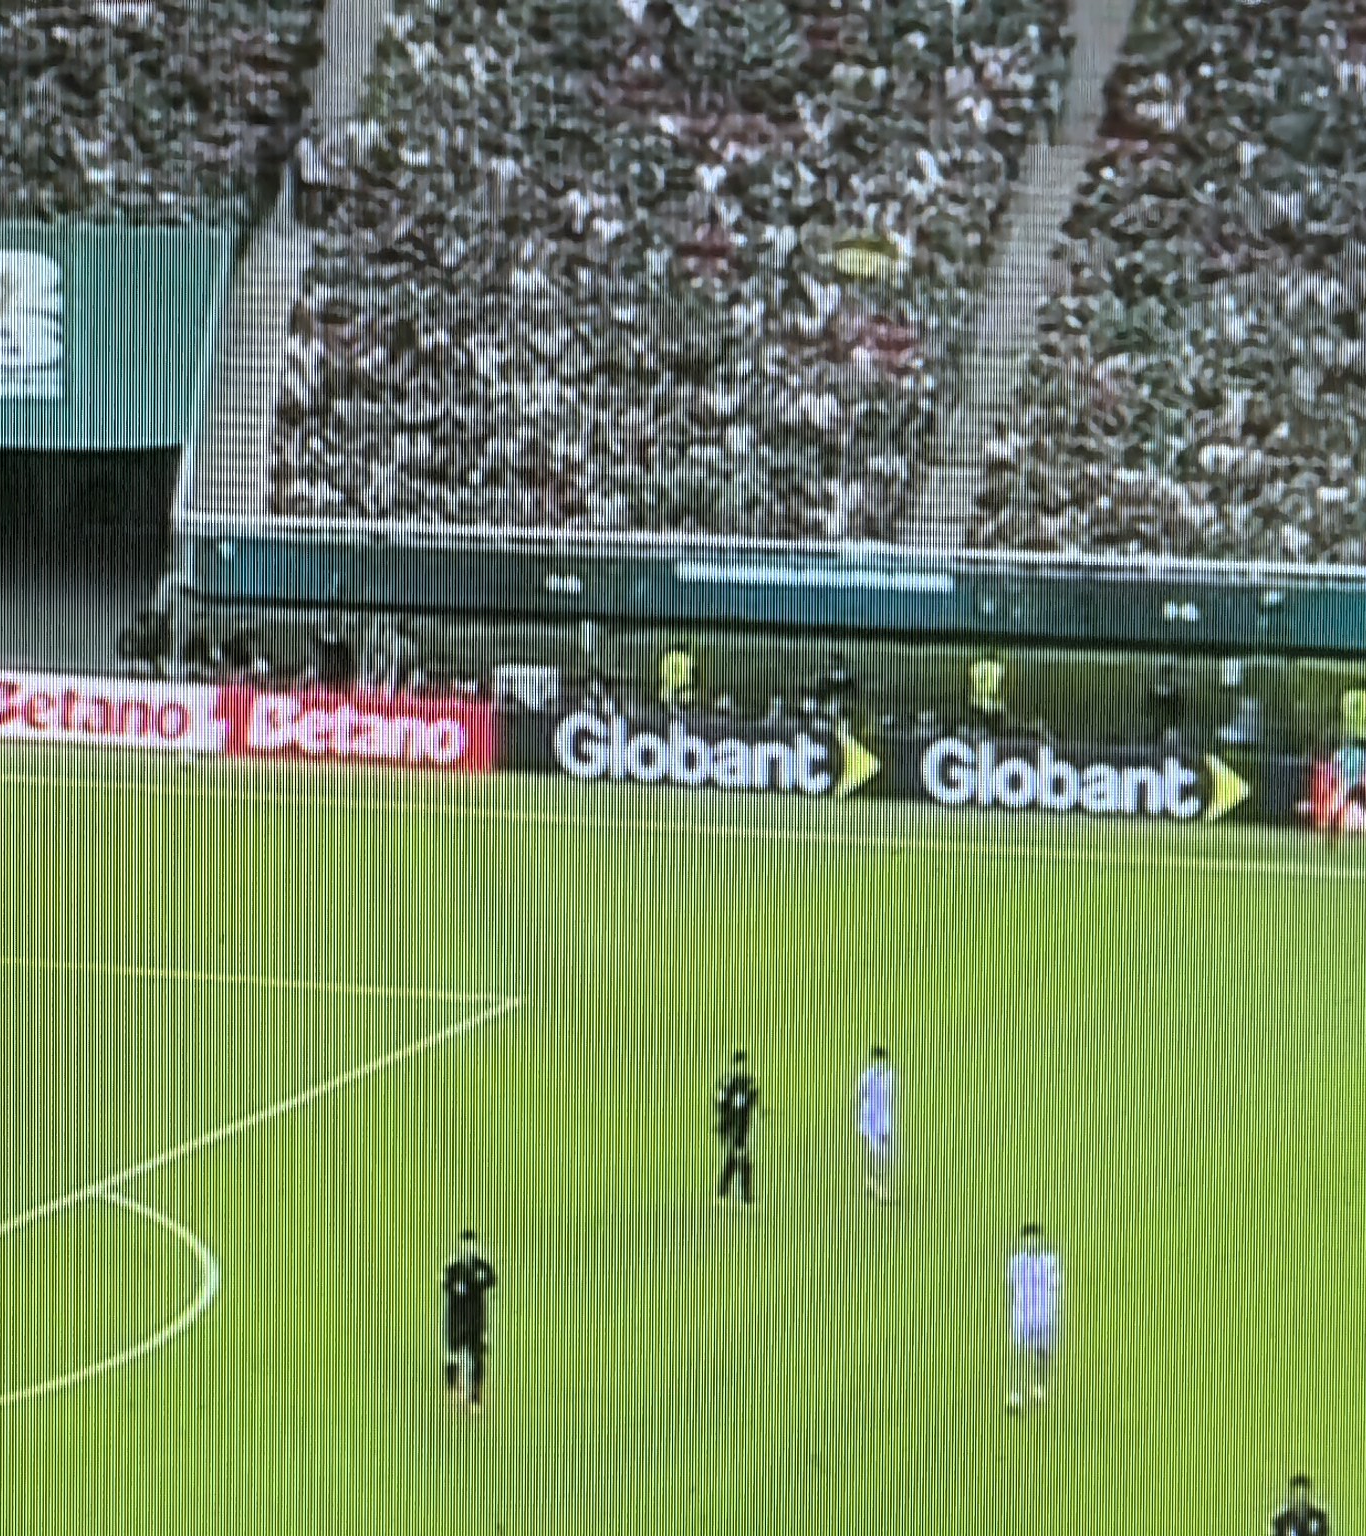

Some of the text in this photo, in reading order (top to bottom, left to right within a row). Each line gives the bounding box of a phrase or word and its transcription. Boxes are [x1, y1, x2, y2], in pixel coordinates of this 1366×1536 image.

[249, 686, 468, 767] Betano
[555, 712, 833, 795] Globant
[921, 735, 1202, 819] Globant
